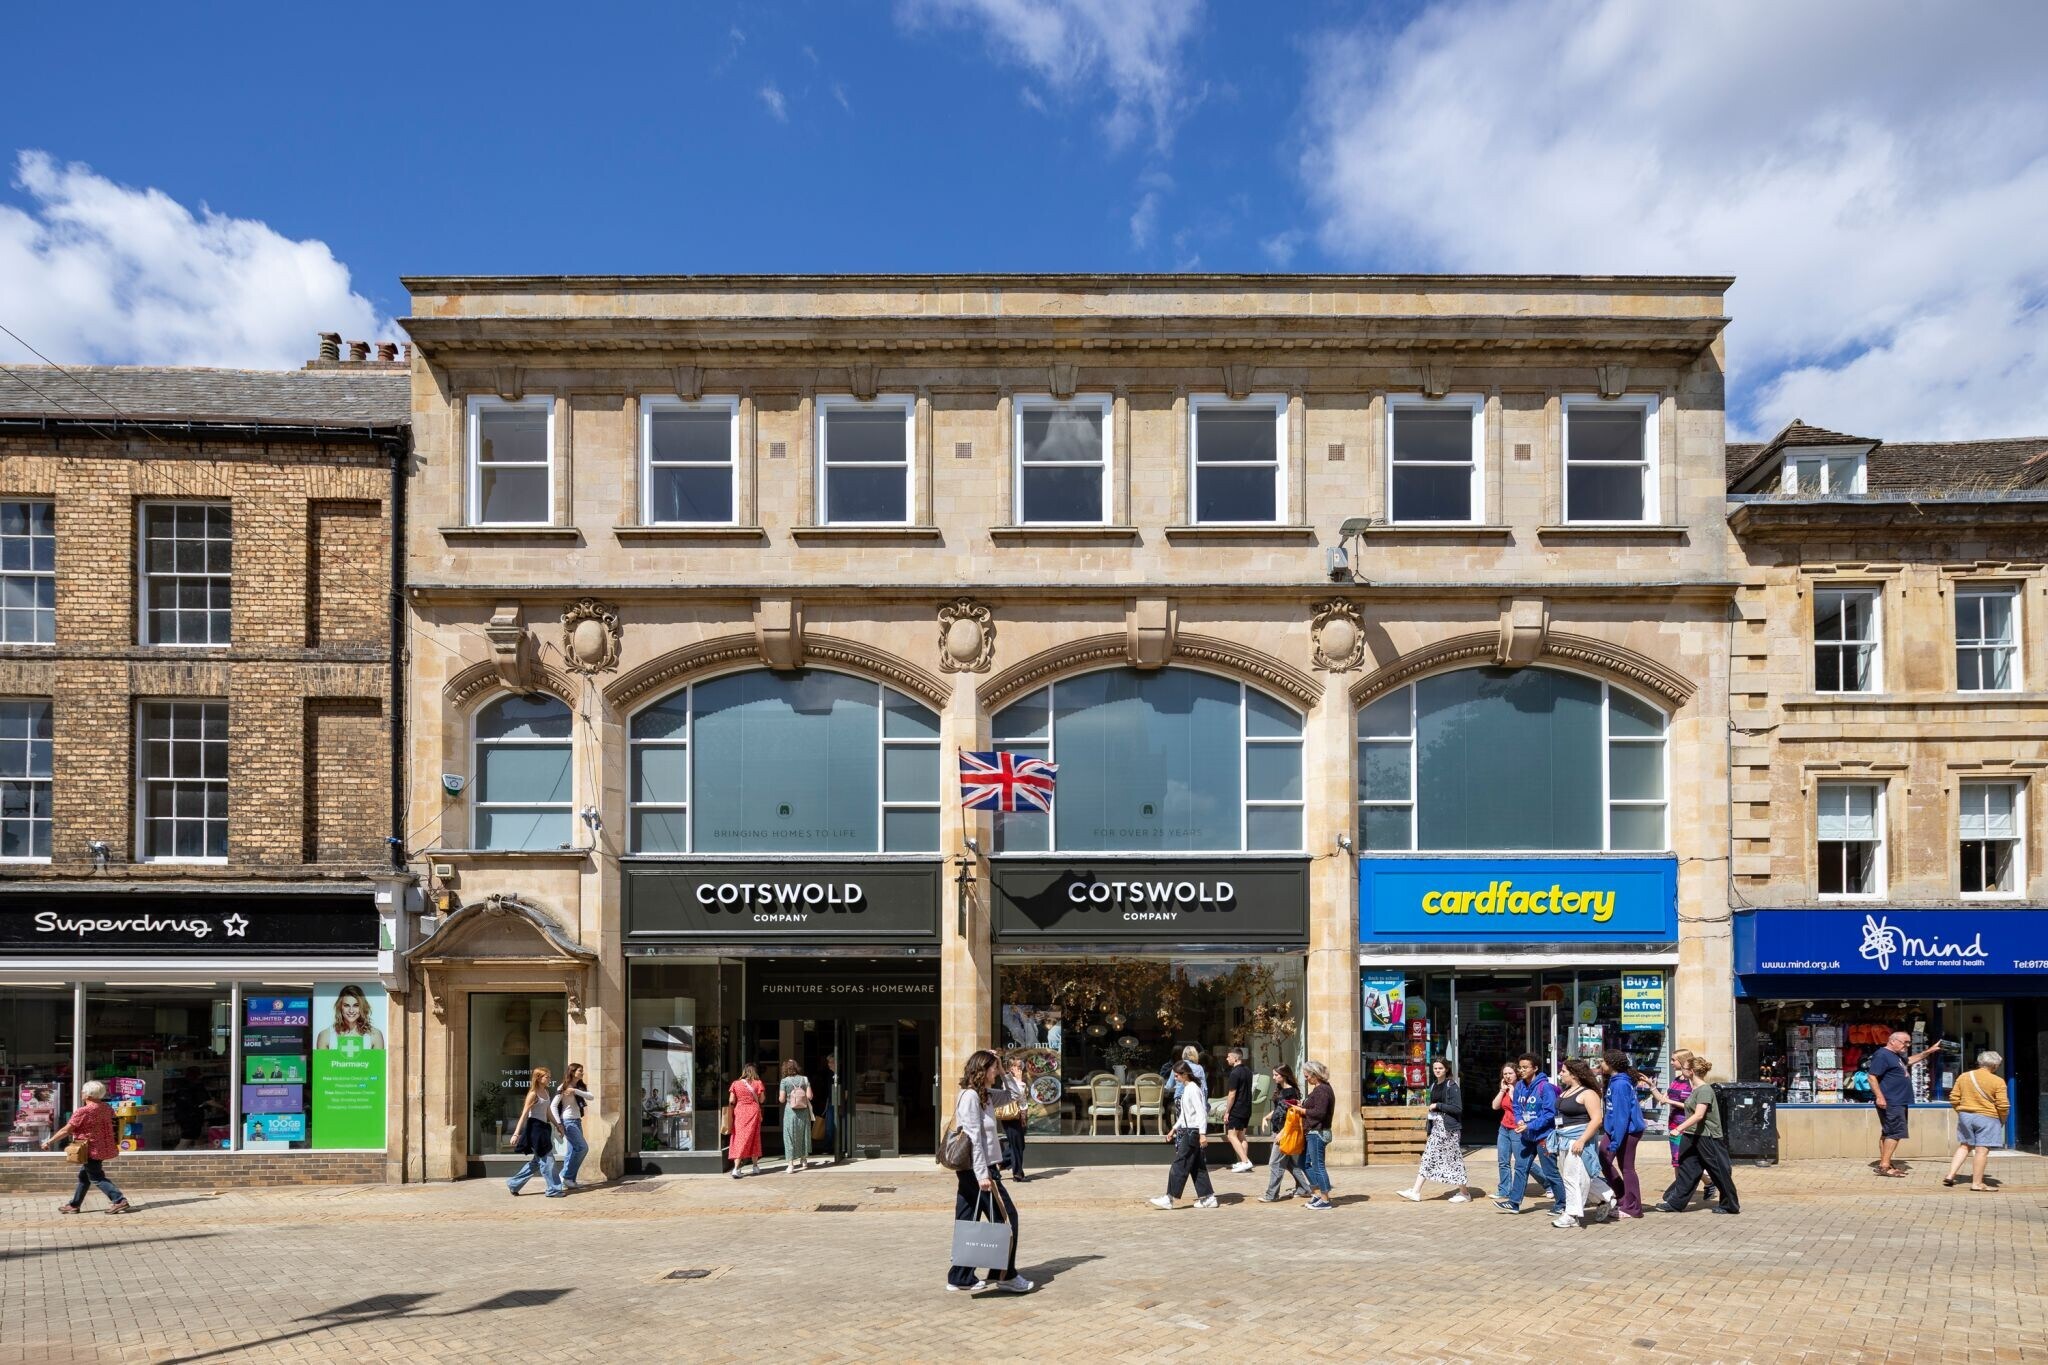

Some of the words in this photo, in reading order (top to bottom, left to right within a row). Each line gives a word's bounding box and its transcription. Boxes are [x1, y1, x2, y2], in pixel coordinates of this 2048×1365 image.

[714, 829, 768, 838] BRINGING
[772, 829, 812, 838] HOMES
[816, 829, 829, 838] TO
[833, 829, 857, 838] LIFE
[1094, 828, 1115, 837] FOR
[1119, 828, 1148, 837] OVER
[1153, 828, 1163, 837] 25
[1168, 828, 1203, 837] YEARS
[696, 883, 863, 904] COTSWOLD
[1068, 882, 1234, 903] COTSWOLD
[1422, 881, 1616, 922] cardfactory
[753, 914, 808, 922] COMPANY
[1123, 912, 1178, 921] COMPANY
[34, 911, 212, 938] Superdrug
[1901, 932, 1989, 957] mind
[1761, 960, 1841, 970] www.mind.org.uk
[1626, 976, 1649, 989] Buy
[1651, 976, 1659, 986] 3
[762, 984, 823, 993] FURNITURE
[830, 984, 865, 993] SOFAS
[872, 984, 935, 993] HOMEWARE
[1624, 1001, 1640, 1010] 4th
[1641, 1001, 1661, 1010] free
[283, 1015, 306, 1025] £20
[331, 1060, 369, 1069] Pharmacy
[501, 1077, 514, 1088] of
[268, 1119, 301, 1128] 100GB
